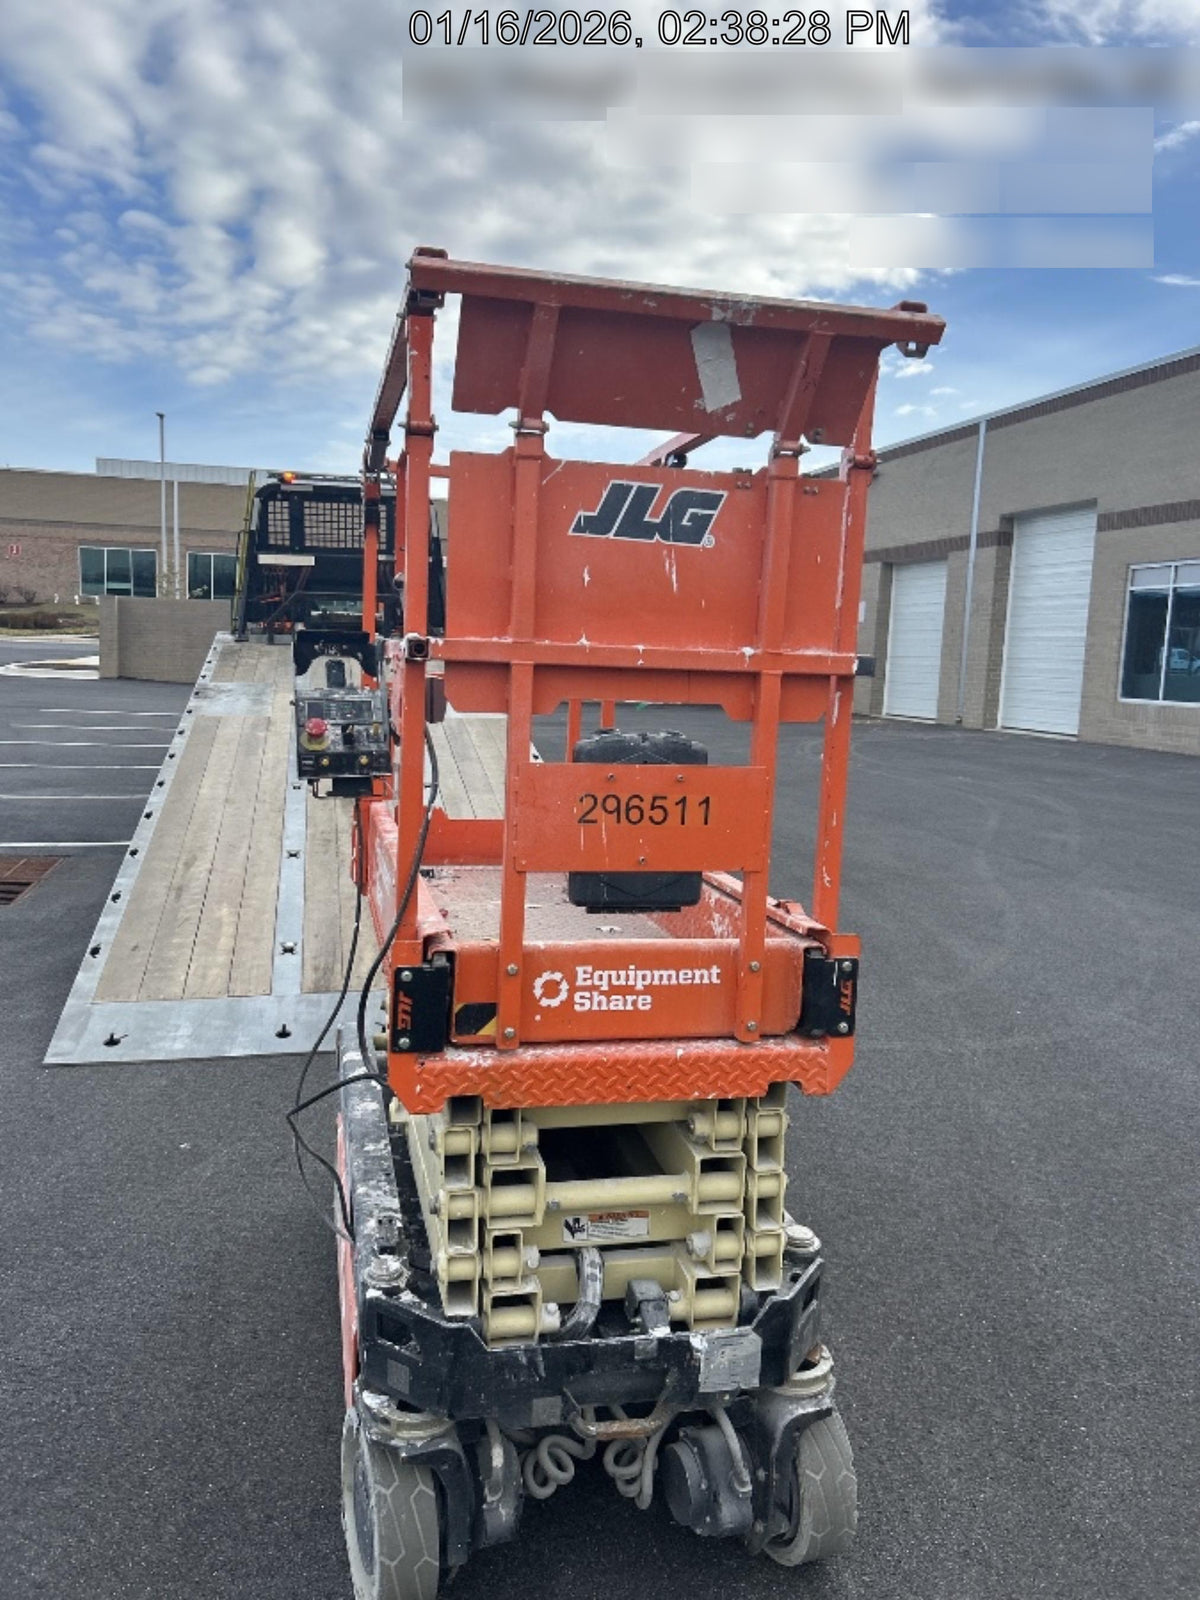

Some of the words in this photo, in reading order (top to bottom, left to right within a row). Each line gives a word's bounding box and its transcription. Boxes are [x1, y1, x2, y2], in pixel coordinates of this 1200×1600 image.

[567, 479, 729, 547] JLG
[577, 793, 711, 826] 296511
[574, 964, 722, 991] Equipment
[397, 990, 413, 1031] JLG
[573, 991, 653, 1012] Share
[839, 979, 853, 1016] JLG
